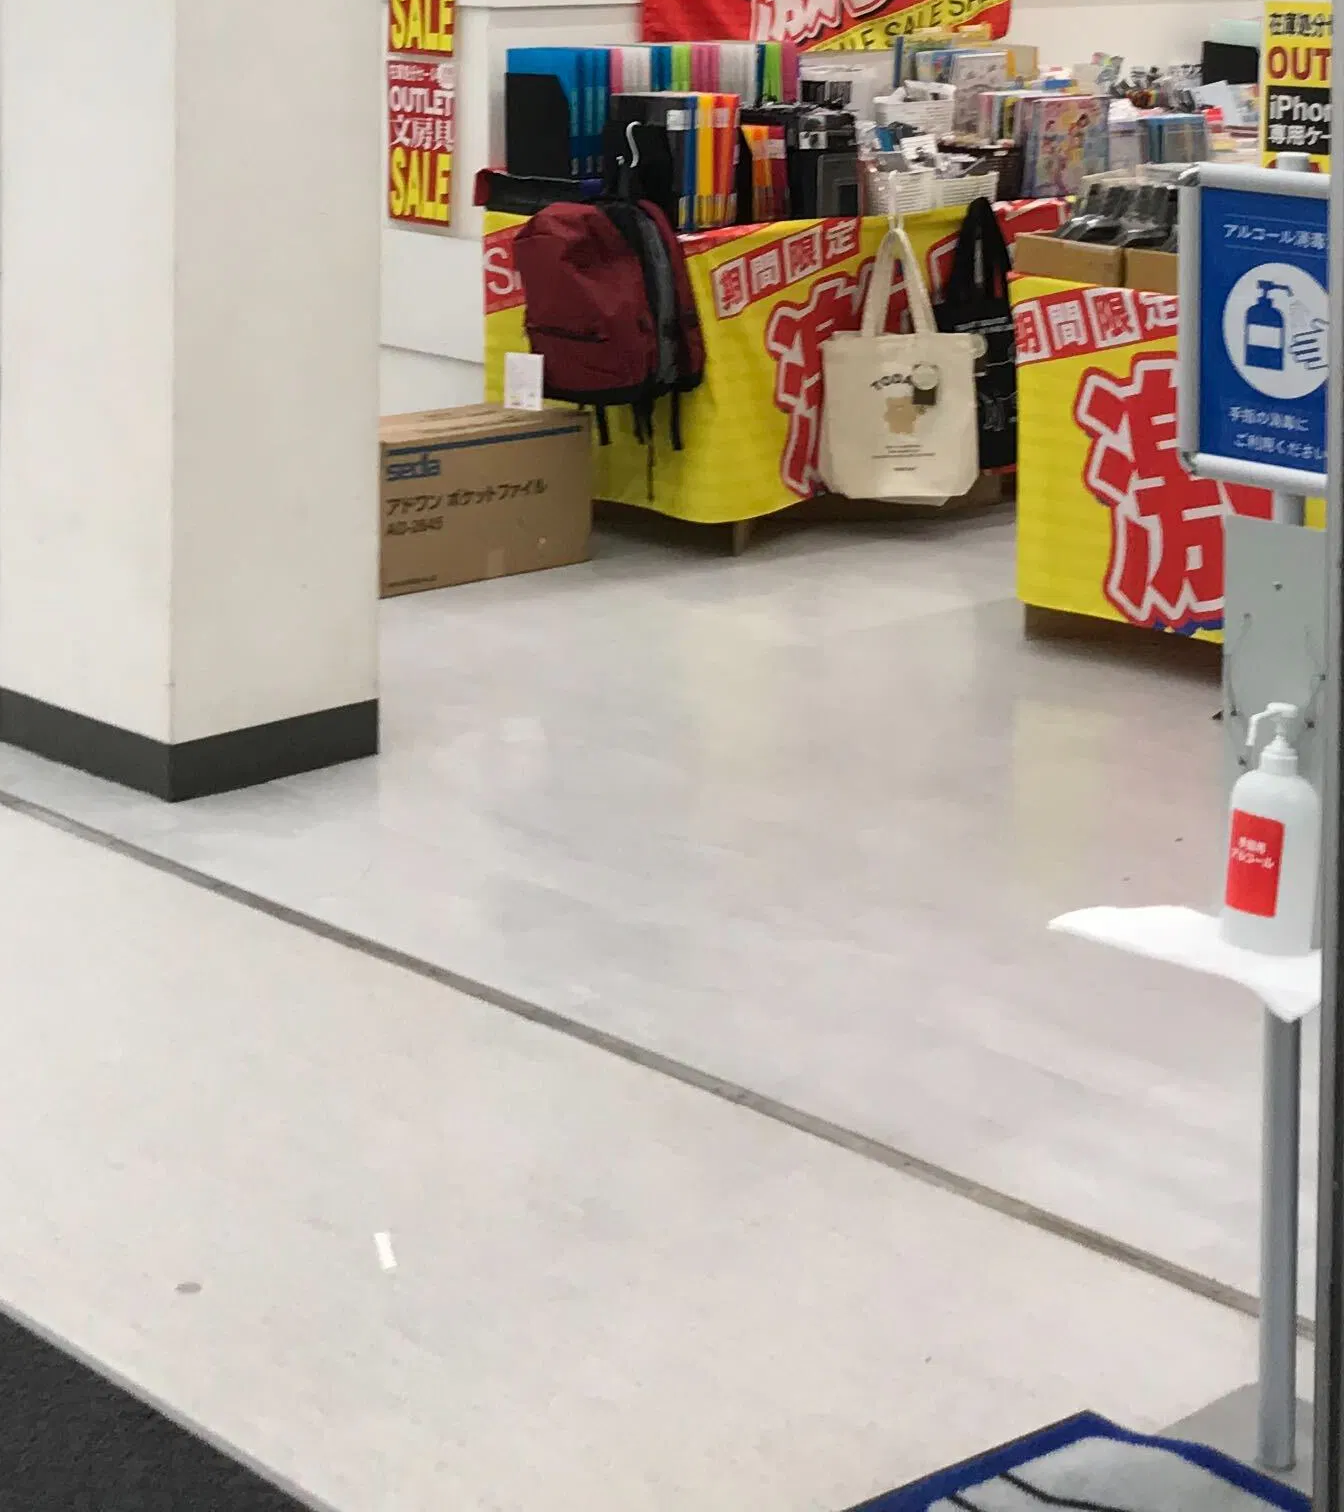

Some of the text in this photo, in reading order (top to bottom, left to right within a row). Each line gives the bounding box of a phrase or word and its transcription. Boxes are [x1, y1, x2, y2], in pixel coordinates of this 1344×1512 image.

[1269, 12, 1333, 37] 在庫処分
[1268, 46, 1332, 80] OUT
[389, 86, 454, 116] OUTLET
[390, 116, 454, 151] 文房具
[1269, 123, 1331, 146] 専用ケー
[391, 147, 451, 221] SALE
[1223, 223, 1328, 250] アルコール消毒
[714, 219, 858, 314] 期間限定
[386, 478, 547, 516] アドワン ポケットファイル
